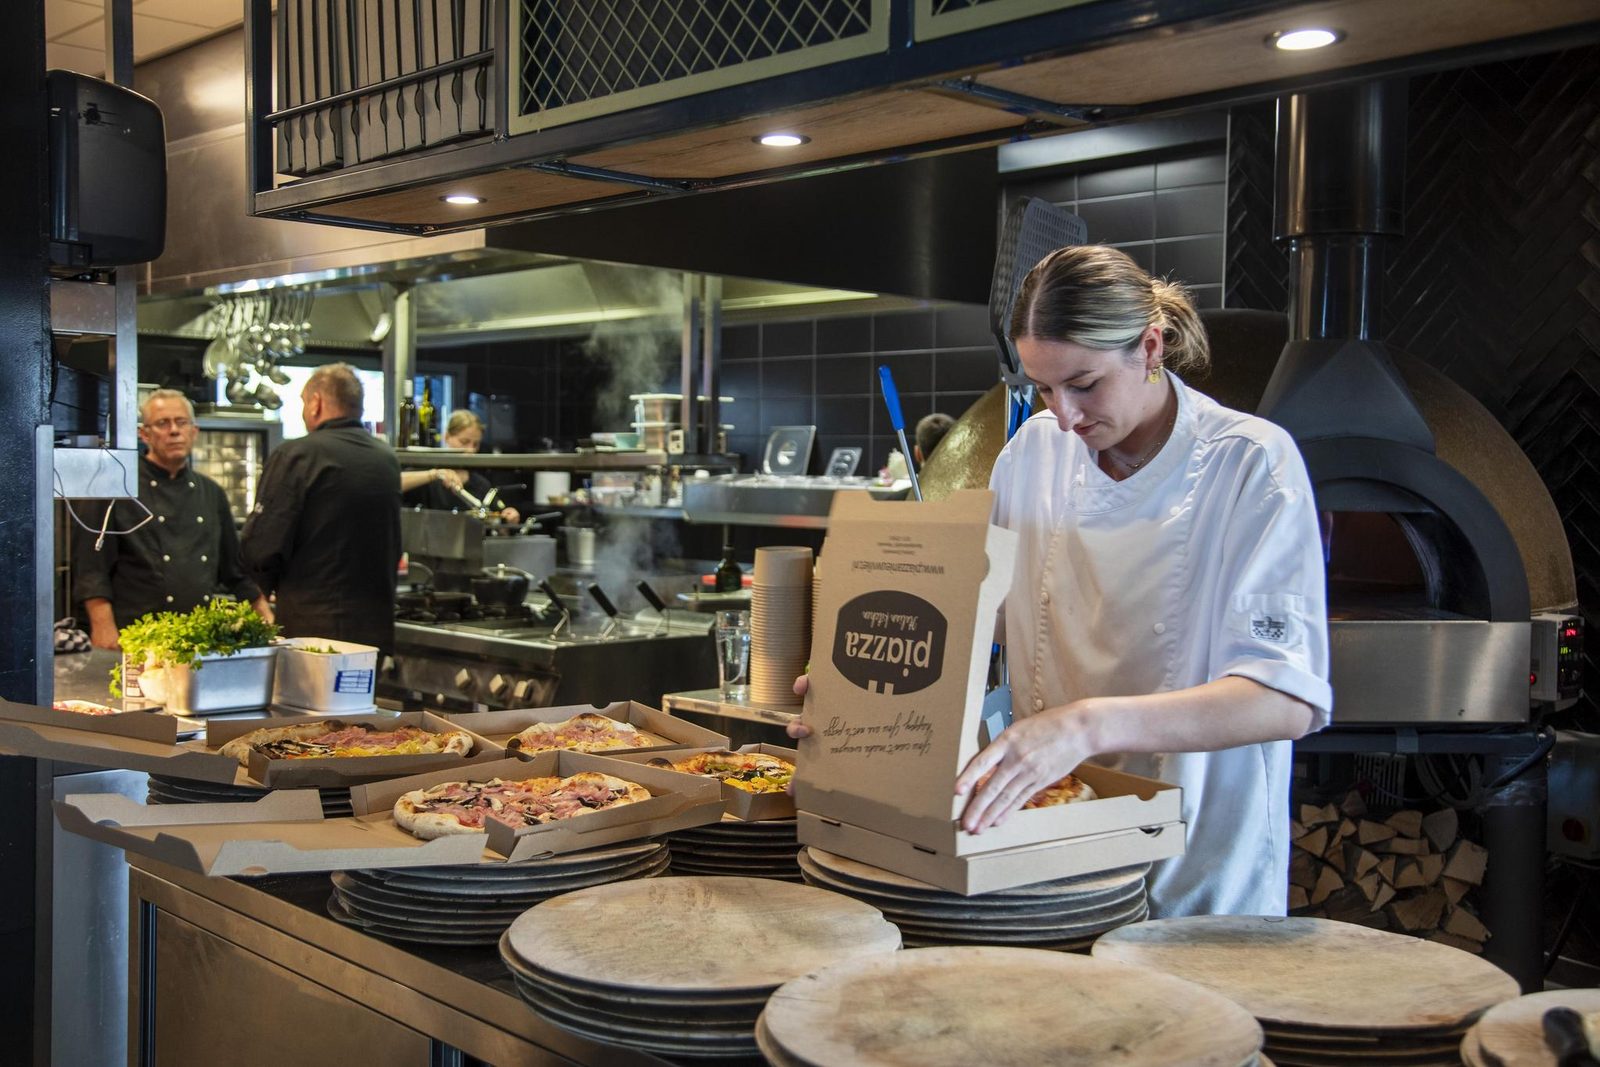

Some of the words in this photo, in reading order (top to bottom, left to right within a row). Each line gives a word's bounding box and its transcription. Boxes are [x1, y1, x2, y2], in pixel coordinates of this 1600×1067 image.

[845, 631, 933, 677] piazza
[884, 712, 902, 739] You
[912, 731, 934, 757] You
